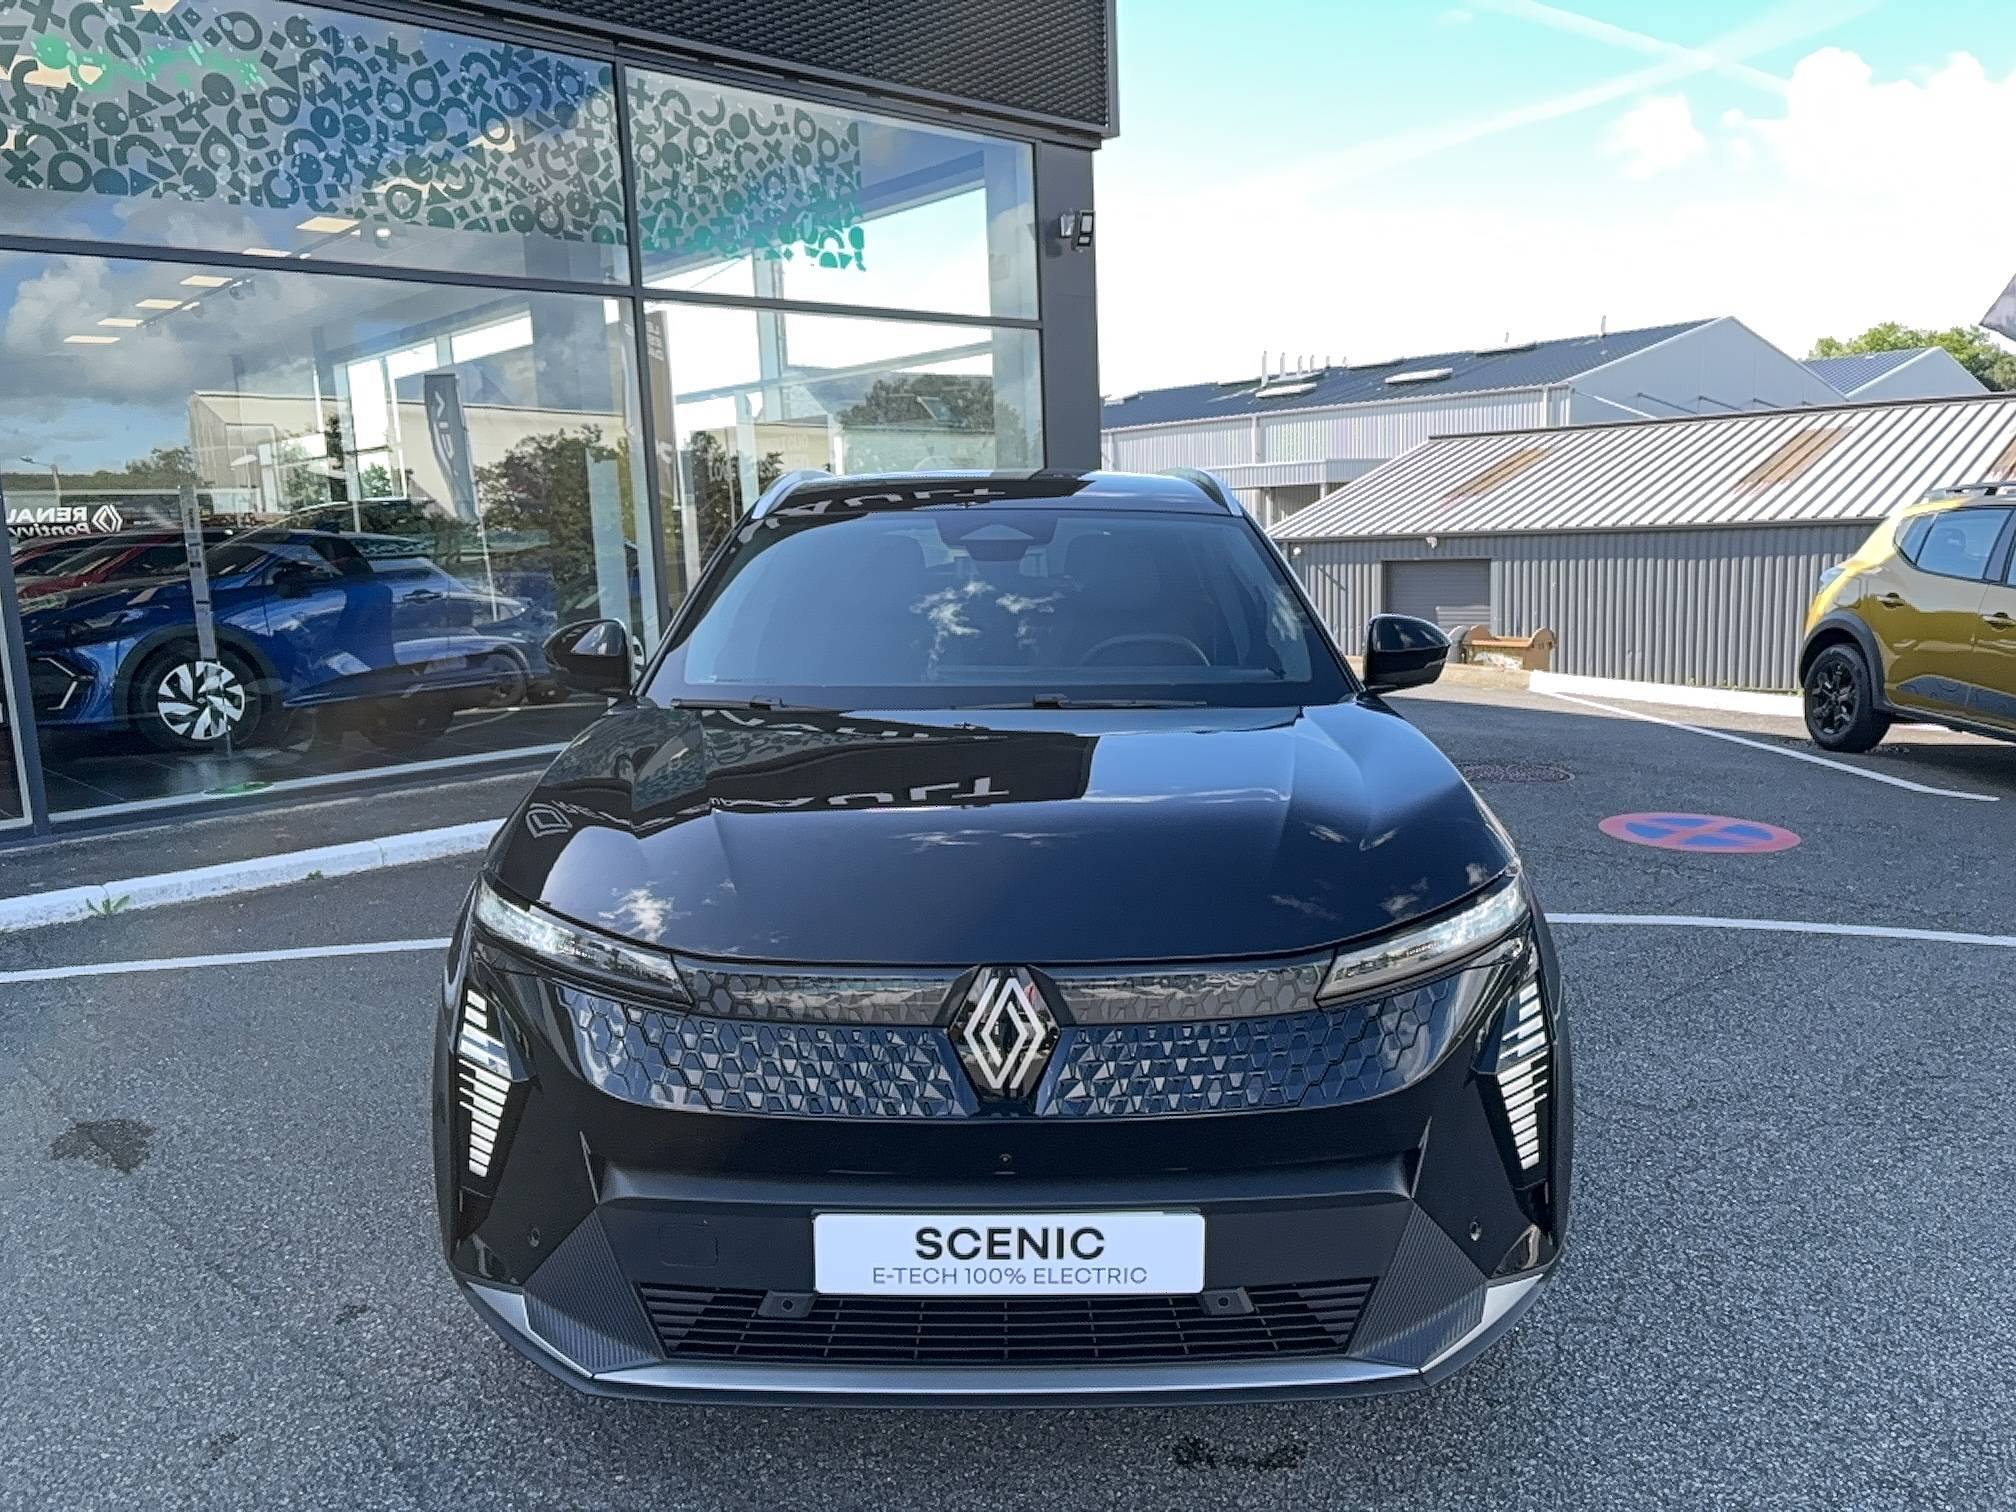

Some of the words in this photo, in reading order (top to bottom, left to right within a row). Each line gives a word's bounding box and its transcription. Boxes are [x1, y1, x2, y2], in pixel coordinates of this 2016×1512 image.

[915, 1226, 1106, 1261] SCENIC
[872, 1267, 958, 1285] E-TECH
[964, 1267, 1027, 1285] 100%
[1033, 1267, 1148, 1285] ELECTRIC
